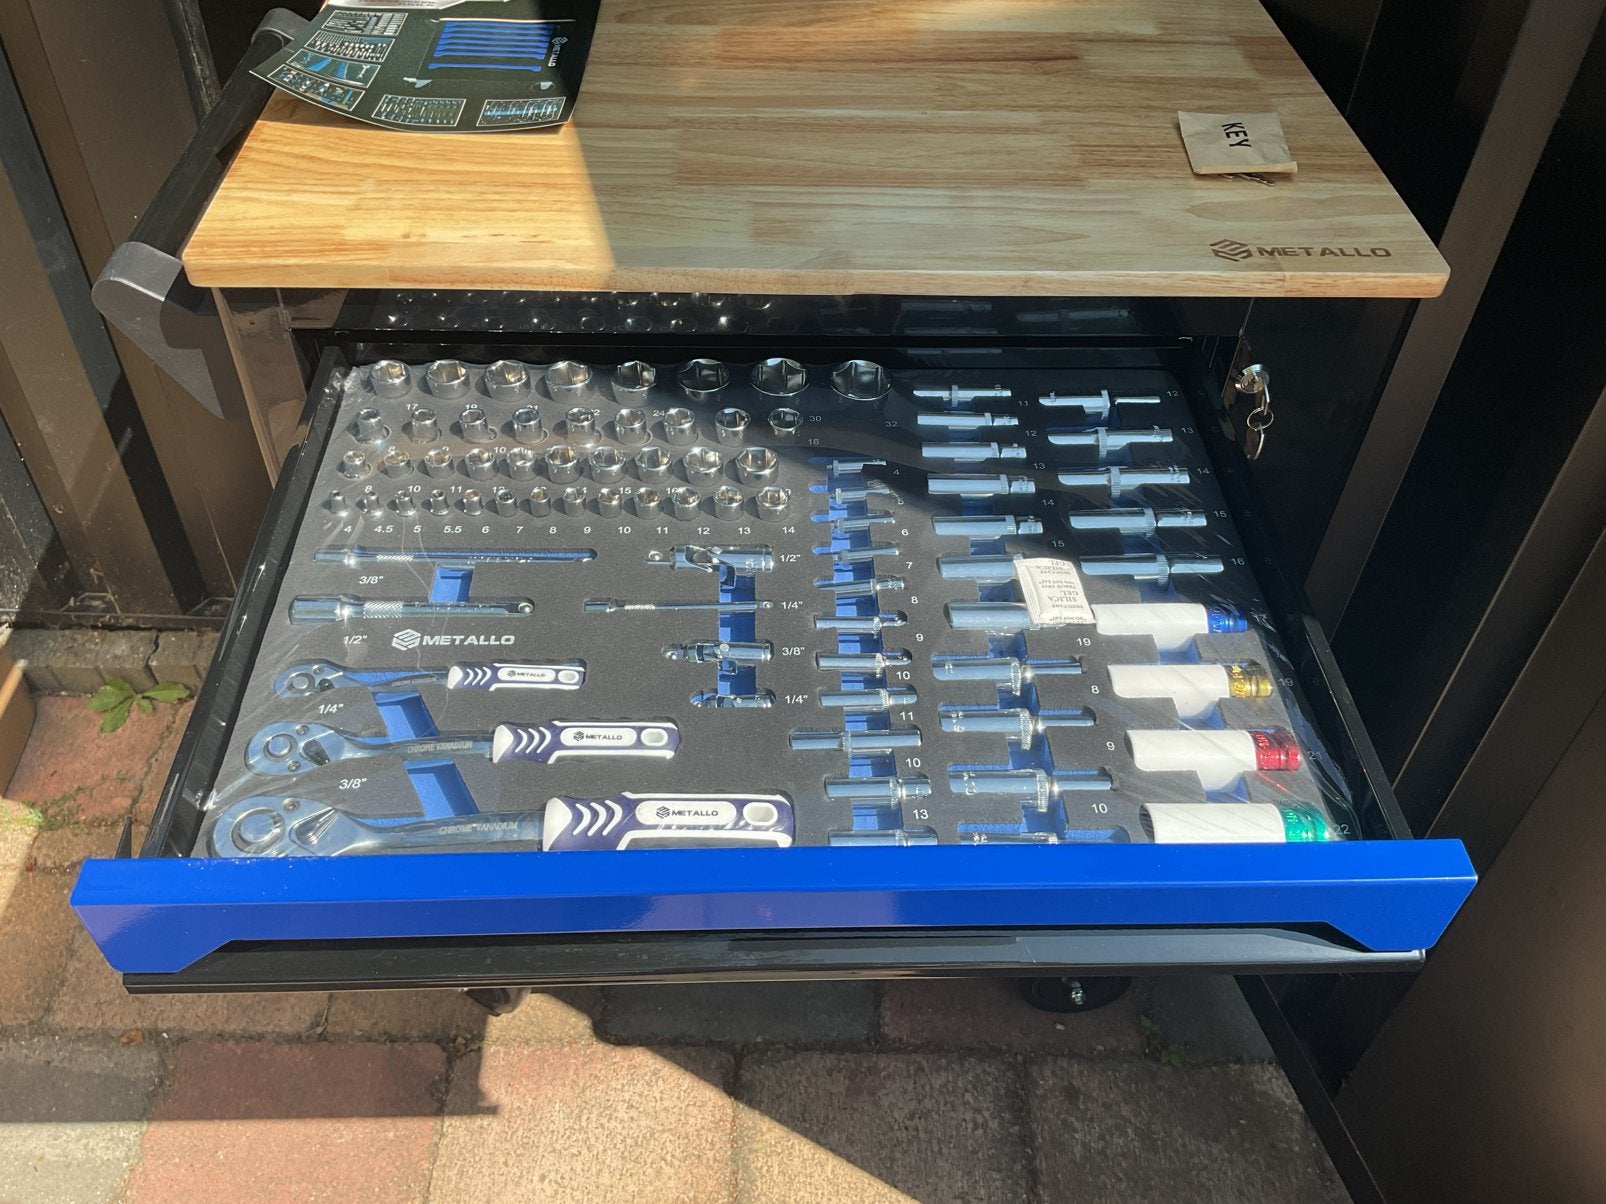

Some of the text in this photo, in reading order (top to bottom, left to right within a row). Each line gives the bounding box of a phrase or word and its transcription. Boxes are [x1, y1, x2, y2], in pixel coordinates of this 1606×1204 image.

[1221, 122, 1252, 148] KEY
[1256, 247, 1392, 257] METALLO
[406, 403, 419, 411] 17
[652, 409, 665, 417] 24
[885, 420, 898, 428] 32
[493, 446, 507, 454] 10
[408, 485, 421, 493] 10
[450, 485, 463, 493] 11
[619, 486, 632, 494] 15
[344, 525, 352, 533] 4
[374, 525, 394, 533] 4.5
[413, 525, 422, 533] 5
[443, 525, 462, 533] 5.5
[583, 526, 592, 534] 9
[617, 526, 632, 534] 10
[656, 526, 669, 534] 11
[696, 526, 711, 535] 12
[738, 526, 751, 535] 13
[782, 526, 796, 535] 14
[901, 528, 909, 536] 6
[906, 561, 913, 569] 7
[911, 596, 919, 604] 8
[422, 635, 515, 645] METALLO
[915, 633, 924, 642] 9
[1076, 637, 1091, 647] 19
[896, 671, 911, 681] 10
[1091, 684, 1100, 694] 8
[900, 711, 914, 721] 11
[1106, 741, 1115, 751] 9
[905, 758, 921, 768] 10
[671, 809, 719, 817] METALLO
[1091, 803, 1108, 815] 10
[912, 808, 929, 820] 13
